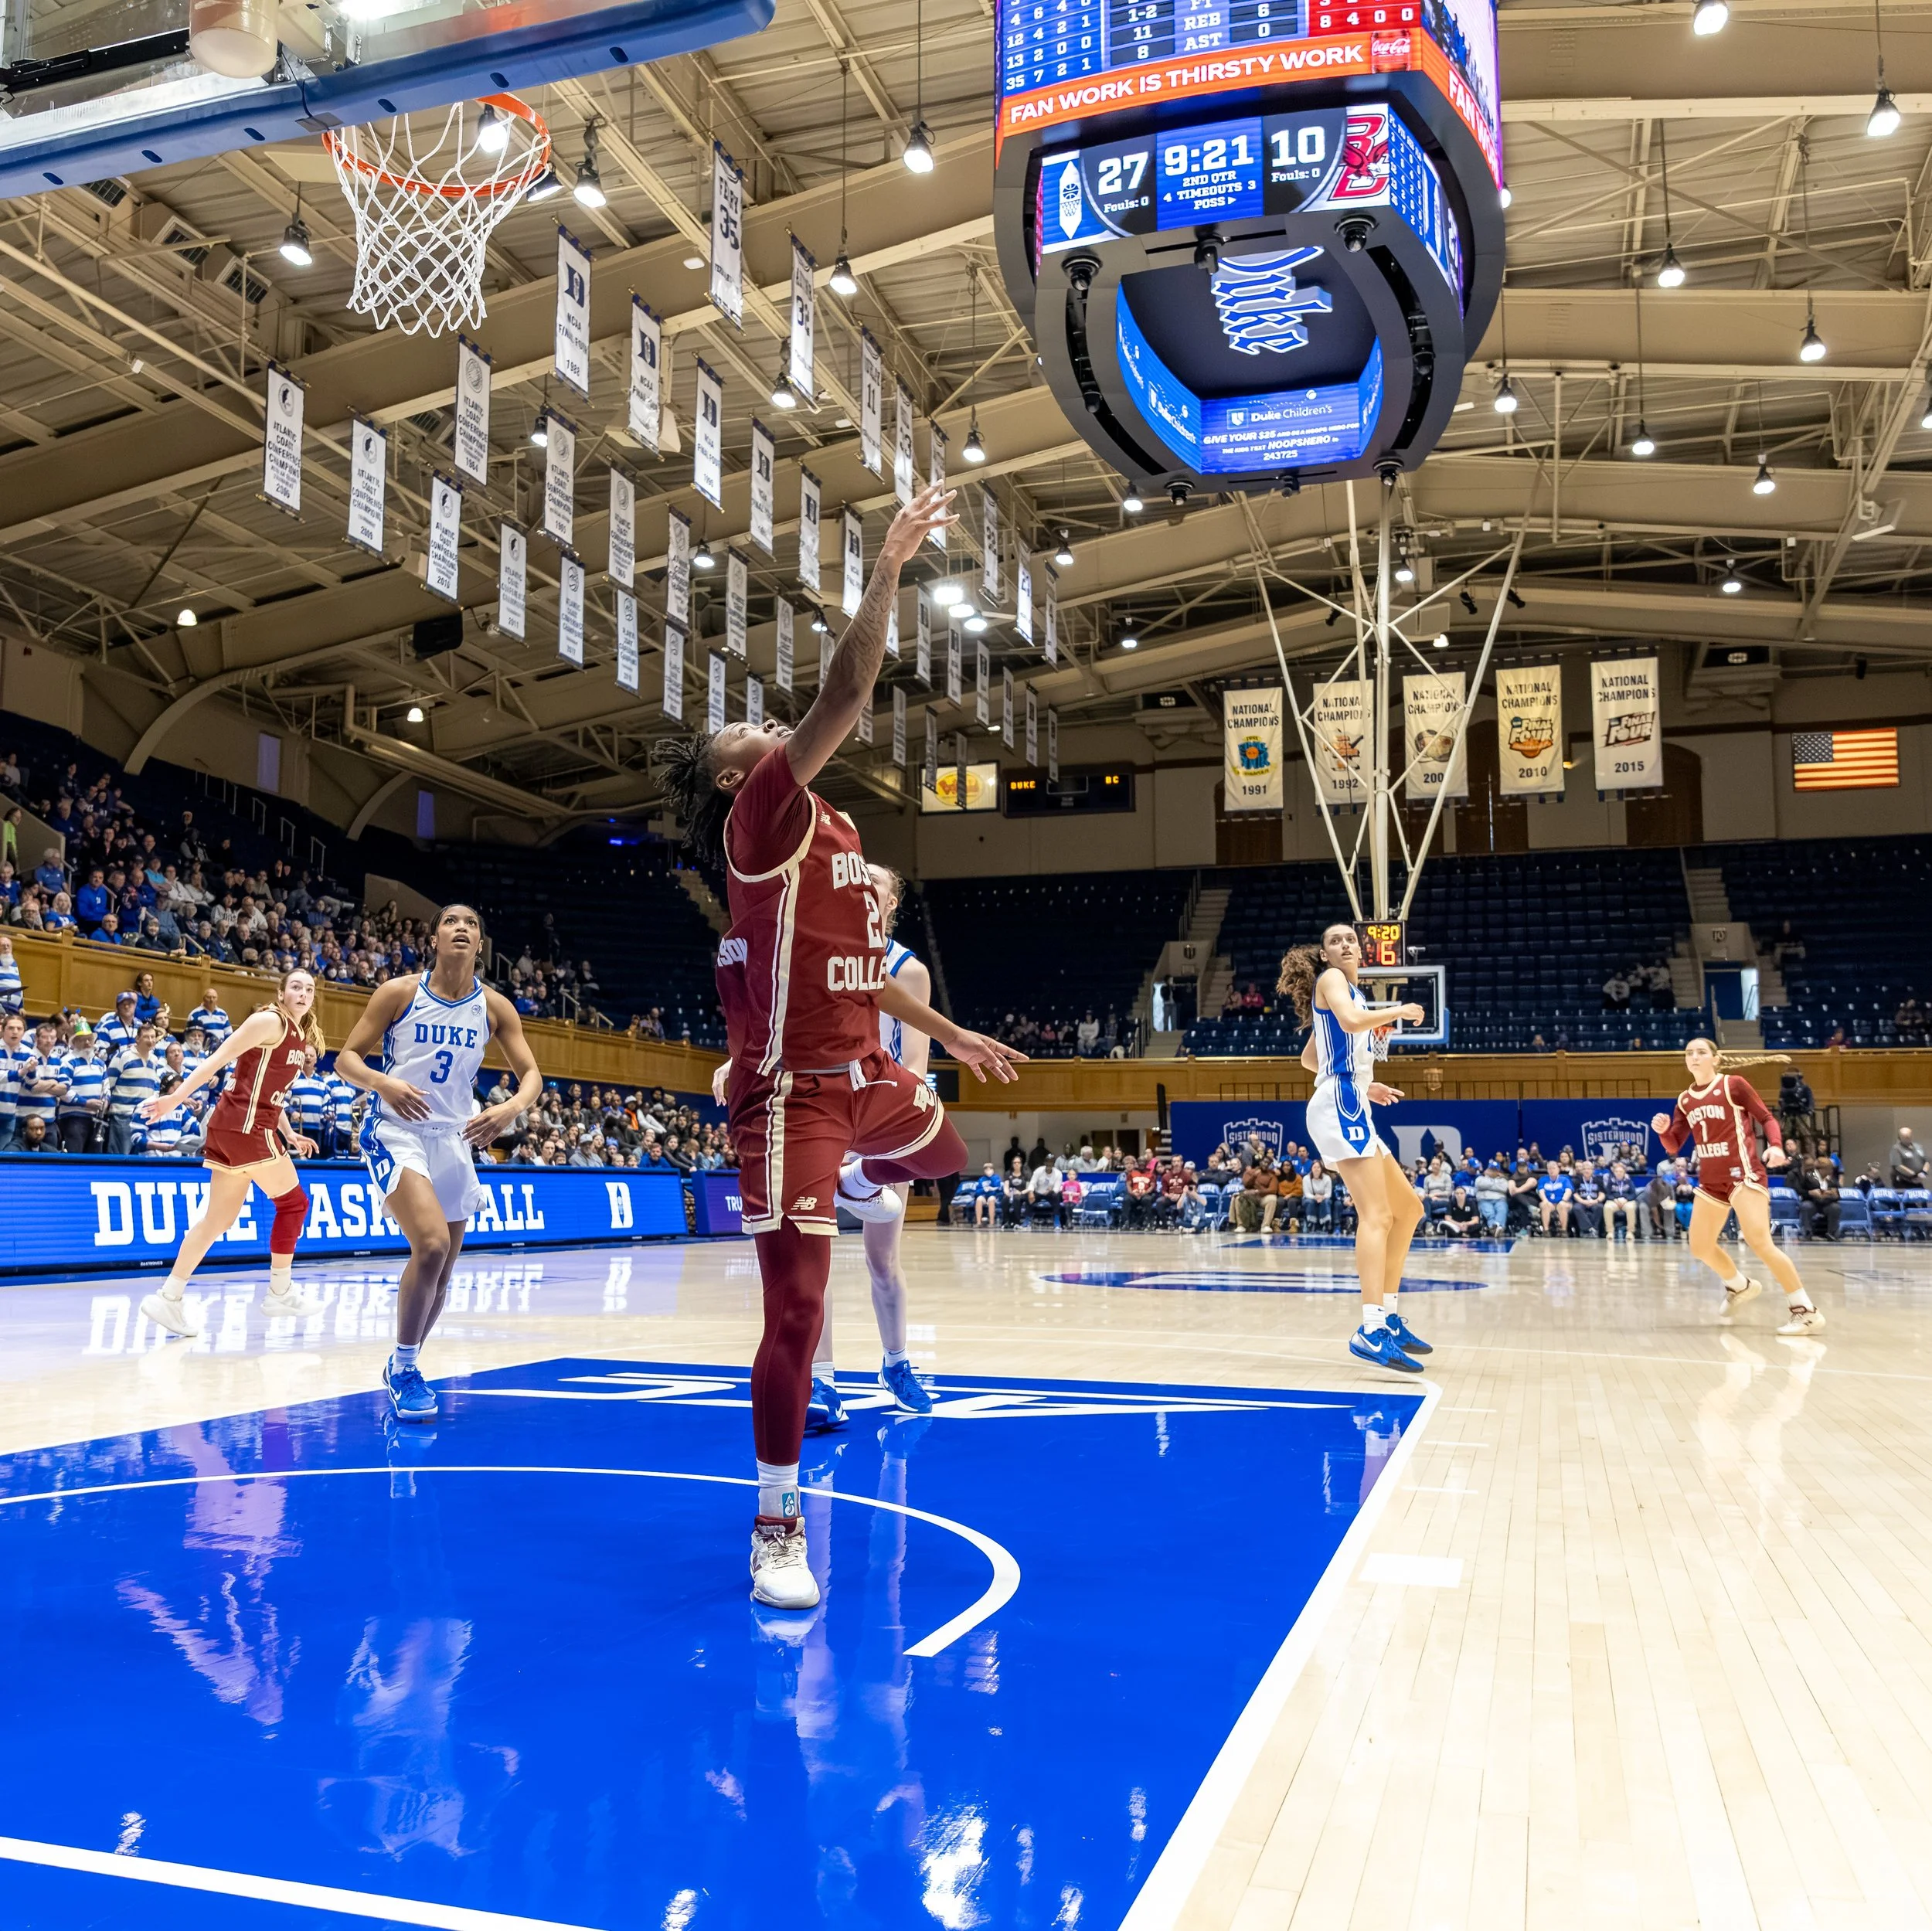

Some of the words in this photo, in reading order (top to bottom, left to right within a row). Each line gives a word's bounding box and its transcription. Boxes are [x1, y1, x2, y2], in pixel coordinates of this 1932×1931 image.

[1010, 13, 1020, 25] 4
[1034, 6, 1043, 19] 6
[1128, 5, 1157, 22] 1-2
[1133, 25, 1152, 40] 11
[1184, 12, 1221, 31] REB
[1257, 4, 1270, 17] 6
[1320, 15, 1332, 28] 8
[1346, 12, 1359, 25] 4
[1374, 10, 1386, 23] 0
[1401, 8, 1413, 21] 0
[1007, 33, 1024, 48] 12
[1033, 28, 1044, 40] 4
[1057, 21, 1067, 34] 2
[1082, 15, 1091, 28] 1
[1138, 45, 1148, 59] 8
[1184, 32, 1222, 51] AST
[1258, 23, 1270, 37] 0
[1007, 54, 1024, 70] 13
[1033, 49, 1043, 61] 2
[1057, 42, 1066, 55] 0
[1081, 36, 1091, 49] 0
[1006, 74, 1025, 90] 35
[1034, 70, 1044, 82] 7
[1057, 63, 1066, 76] 2
[1082, 57, 1090, 70] 1
[1010, 97, 1054, 124] FAN
[1059, 79, 1134, 110] WORK
[1139, 73, 1162, 93] IS
[1165, 55, 1275, 87] THIRSTY
[1279, 45, 1364, 70] WORK
[1448, 70, 1477, 130] FAN
[1164, 134, 1254, 176] 9:21
[1270, 125, 1326, 168] 10
[1097, 151, 1149, 195] 27
[1182, 176, 1209, 188] 2ND
[1210, 170, 1236, 183] QTR
[1271, 170, 1310, 182] Fouls:
[1311, 168, 1321, 178] 0
[1163, 193, 1172, 202] 4
[1176, 182, 1243, 201] TIMEOUTS
[1247, 180, 1257, 190] 3
[1103, 199, 1139, 213] Fouls:
[1140, 195, 1149, 206] 0
[1193, 197, 1226, 210] POSS
[1250, 410, 1281, 423] Duke
[1283, 404, 1332, 419] Children's
[1203, 433, 1229, 444] GIVE
[1229, 431, 1257, 442] YOUR
[1258, 430, 1277, 440] $25
[1267, 434, 1331, 450] HOOPSHERO
[1263, 450, 1298, 461] 243725
[1506, 682, 1552, 695] NATIONAL
[1601, 675, 1648, 688] NATIONAL
[1322, 696, 1363, 709] NATIONA
[1413, 689, 1456, 701] NATIONA
[1502, 695, 1557, 709] CHAMPIONS
[1597, 688, 1655, 703] CHAMPIONS
[1232, 702, 1275, 716] NATIONAL
[1318, 709, 1371, 722] CHAMPIOS
[1227, 714, 1280, 729] CHAMPIONS
[1522, 719, 1553, 731] FINAL
[1621, 712, 1655, 726] FINAL
[1509, 727, 1553, 744] FOUR
[1608, 722, 1654, 743] FOUR
[1519, 767, 1548, 778] 2010
[1614, 760, 1645, 773] 2015
[1010, 780, 1036, 790] DUKE
[1104, 775, 1119, 785] BC
[1332, 779, 1359, 790] 1992
[1423, 773, 1444, 784] 200
[1242, 785, 1267, 796] 1991
[863, 891, 884, 949] 2
[1367, 924, 1400, 940] 9:20
[1379, 940, 1396, 966] 6
[414, 1023, 478, 1049] DUKE
[430, 1050, 454, 1083] 3
[1587, 1130, 1645, 1146] SISTERHOOD
[1699, 1120, 1708, 1143] 1
[297, 1182, 545, 1238] ASKALL
